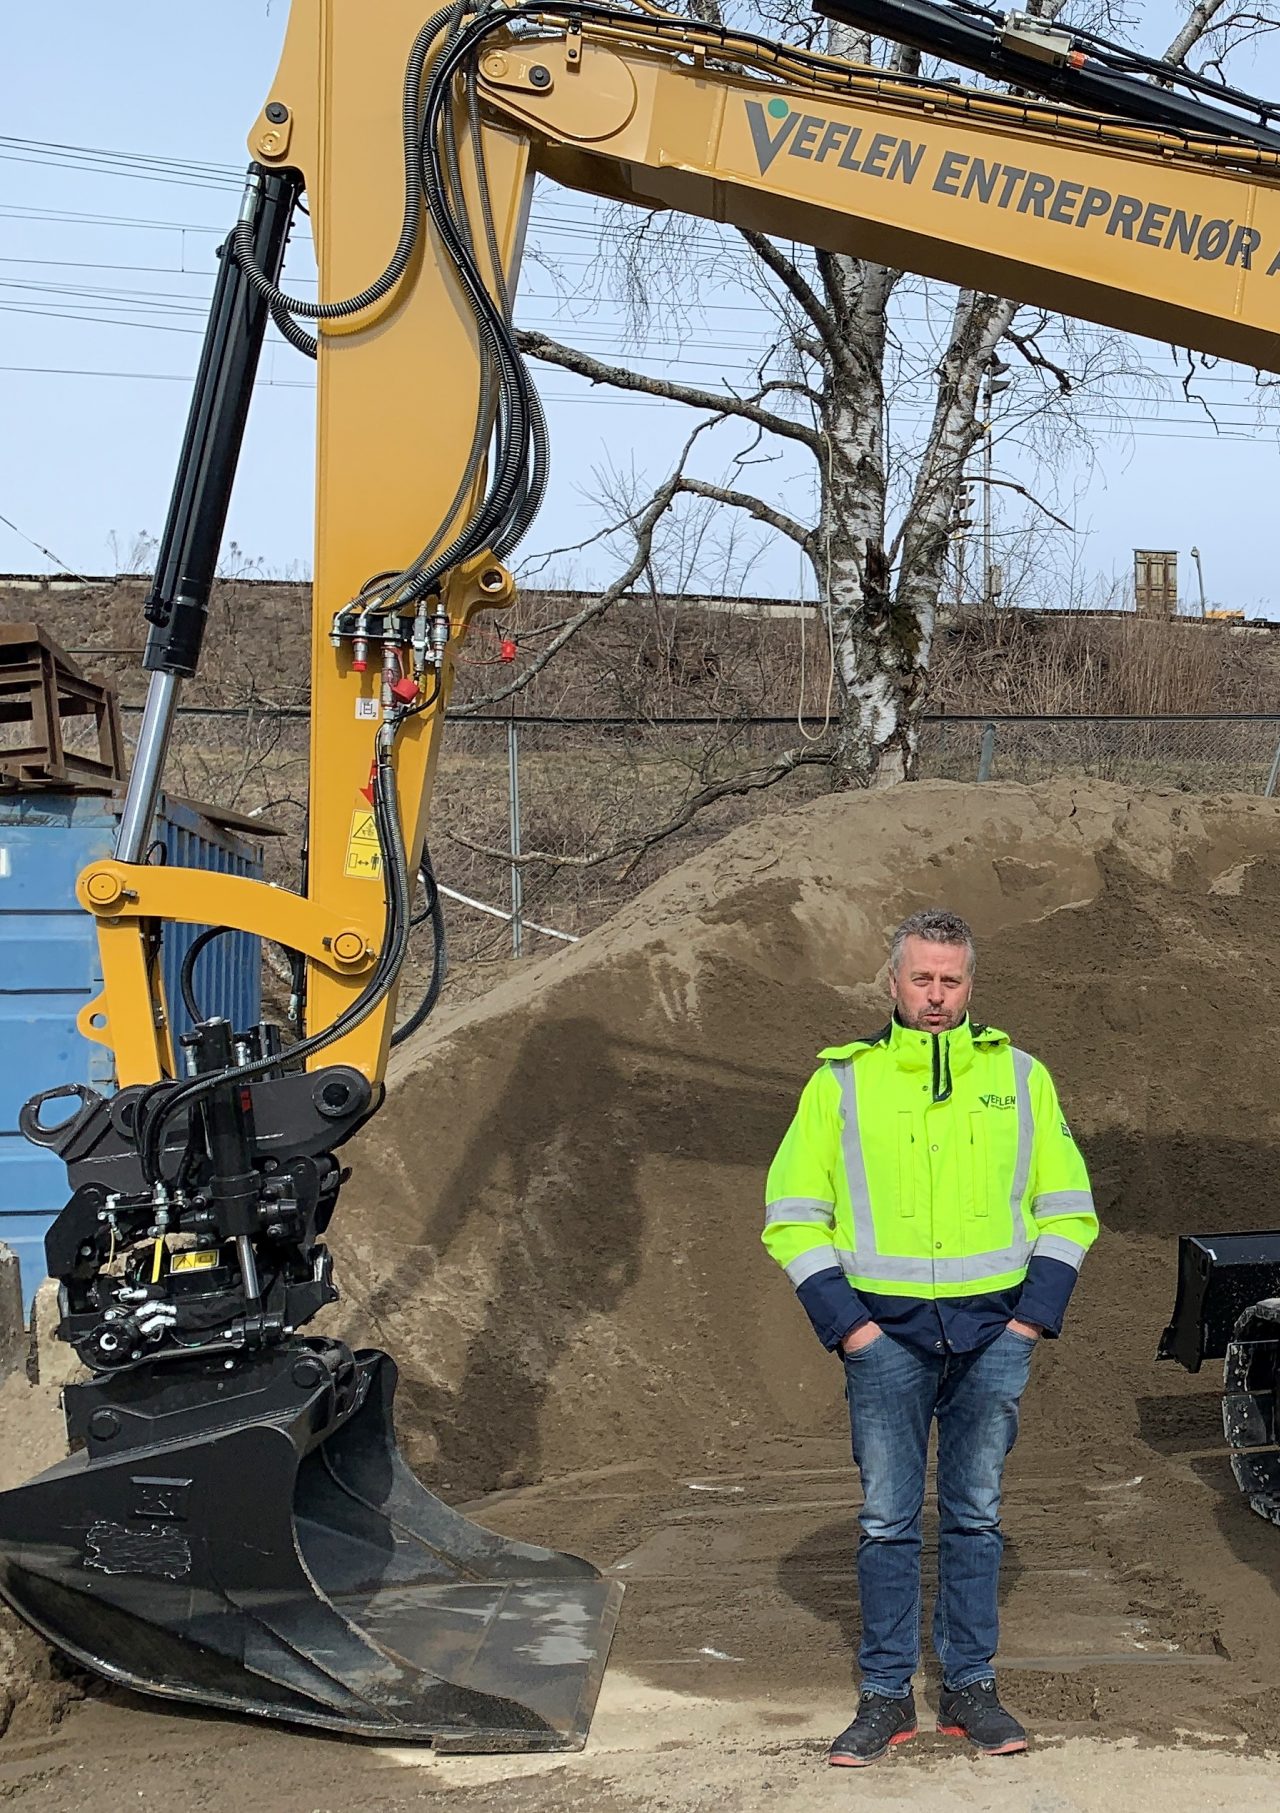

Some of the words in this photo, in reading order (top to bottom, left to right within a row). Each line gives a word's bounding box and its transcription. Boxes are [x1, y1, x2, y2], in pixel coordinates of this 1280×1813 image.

[744, 99, 926, 184] VEFLEN
[932, 150, 1262, 270] ENTREPRENØR
[978, 1094, 1016, 1108] VEFLEN
